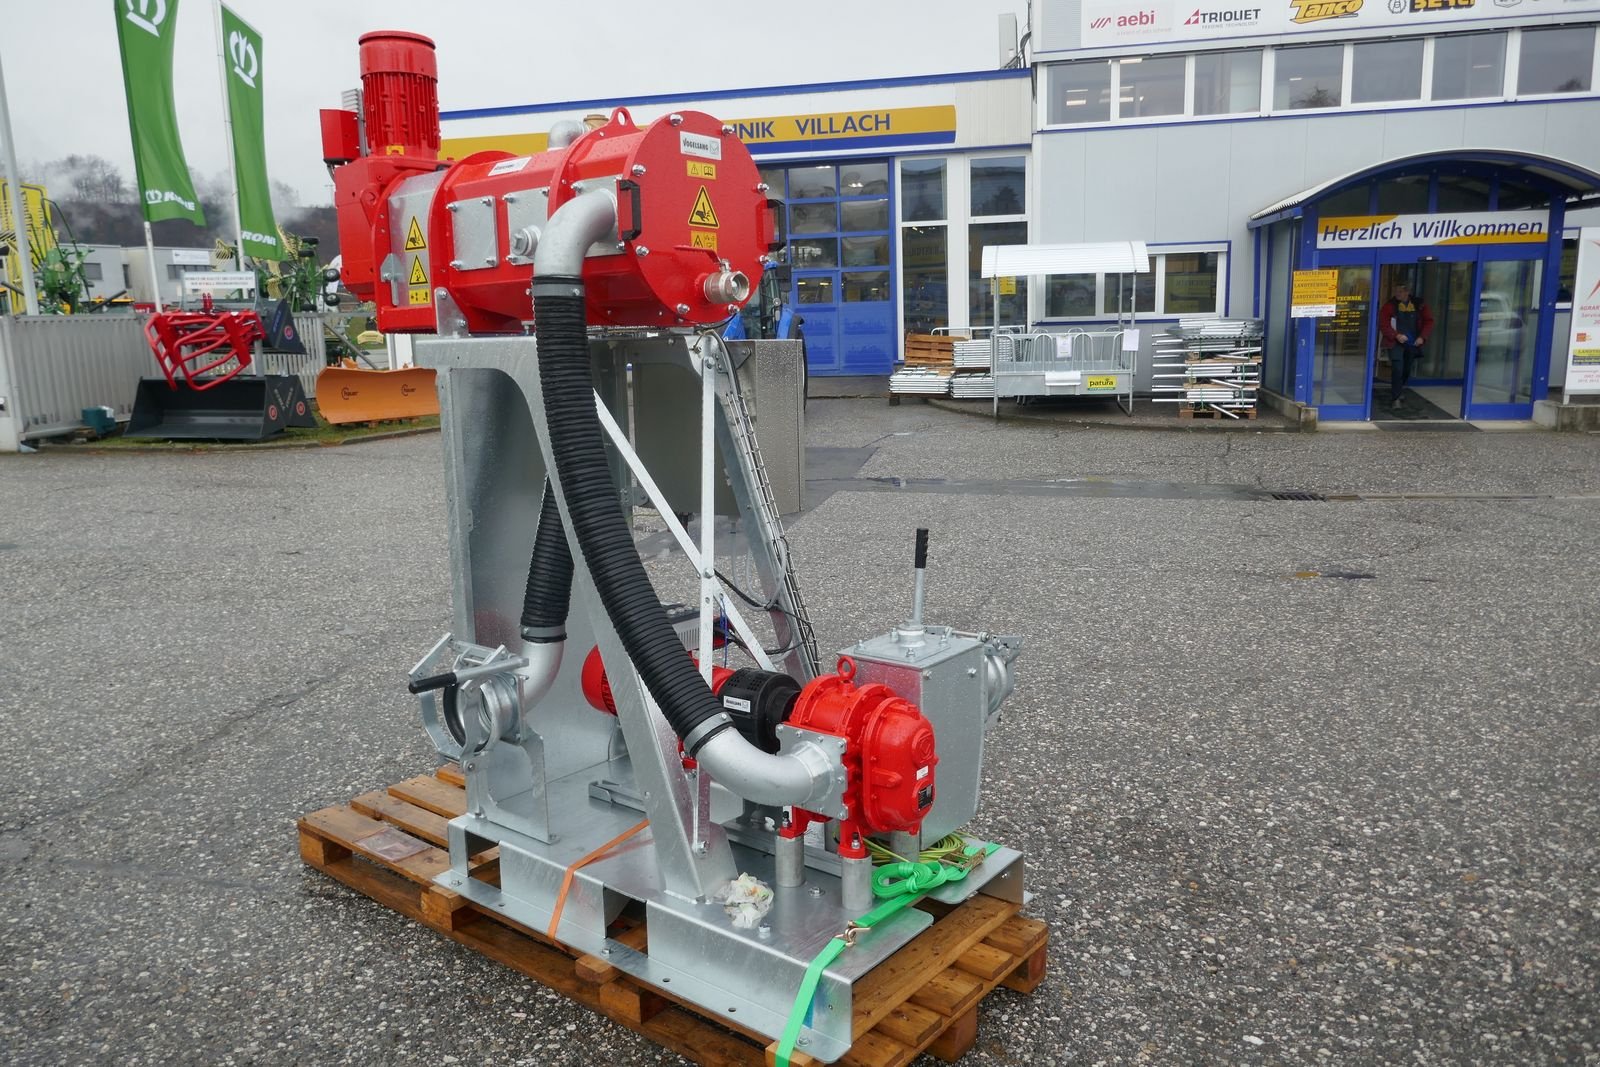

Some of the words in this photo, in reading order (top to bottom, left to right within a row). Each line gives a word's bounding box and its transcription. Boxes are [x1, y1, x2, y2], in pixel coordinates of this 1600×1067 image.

[1200, 9, 1261, 24] TRIOLIET
[1290, 0, 1363, 19] Tanco
[1117, 11, 1155, 27] aebi
[795, 113, 891, 136] VILLACH
[682, 138, 709, 151] VOGELSANG
[1322, 221, 1402, 242] Herzlich
[1412, 219, 1543, 239] Willkommen
[1089, 378, 1114, 387] patura
